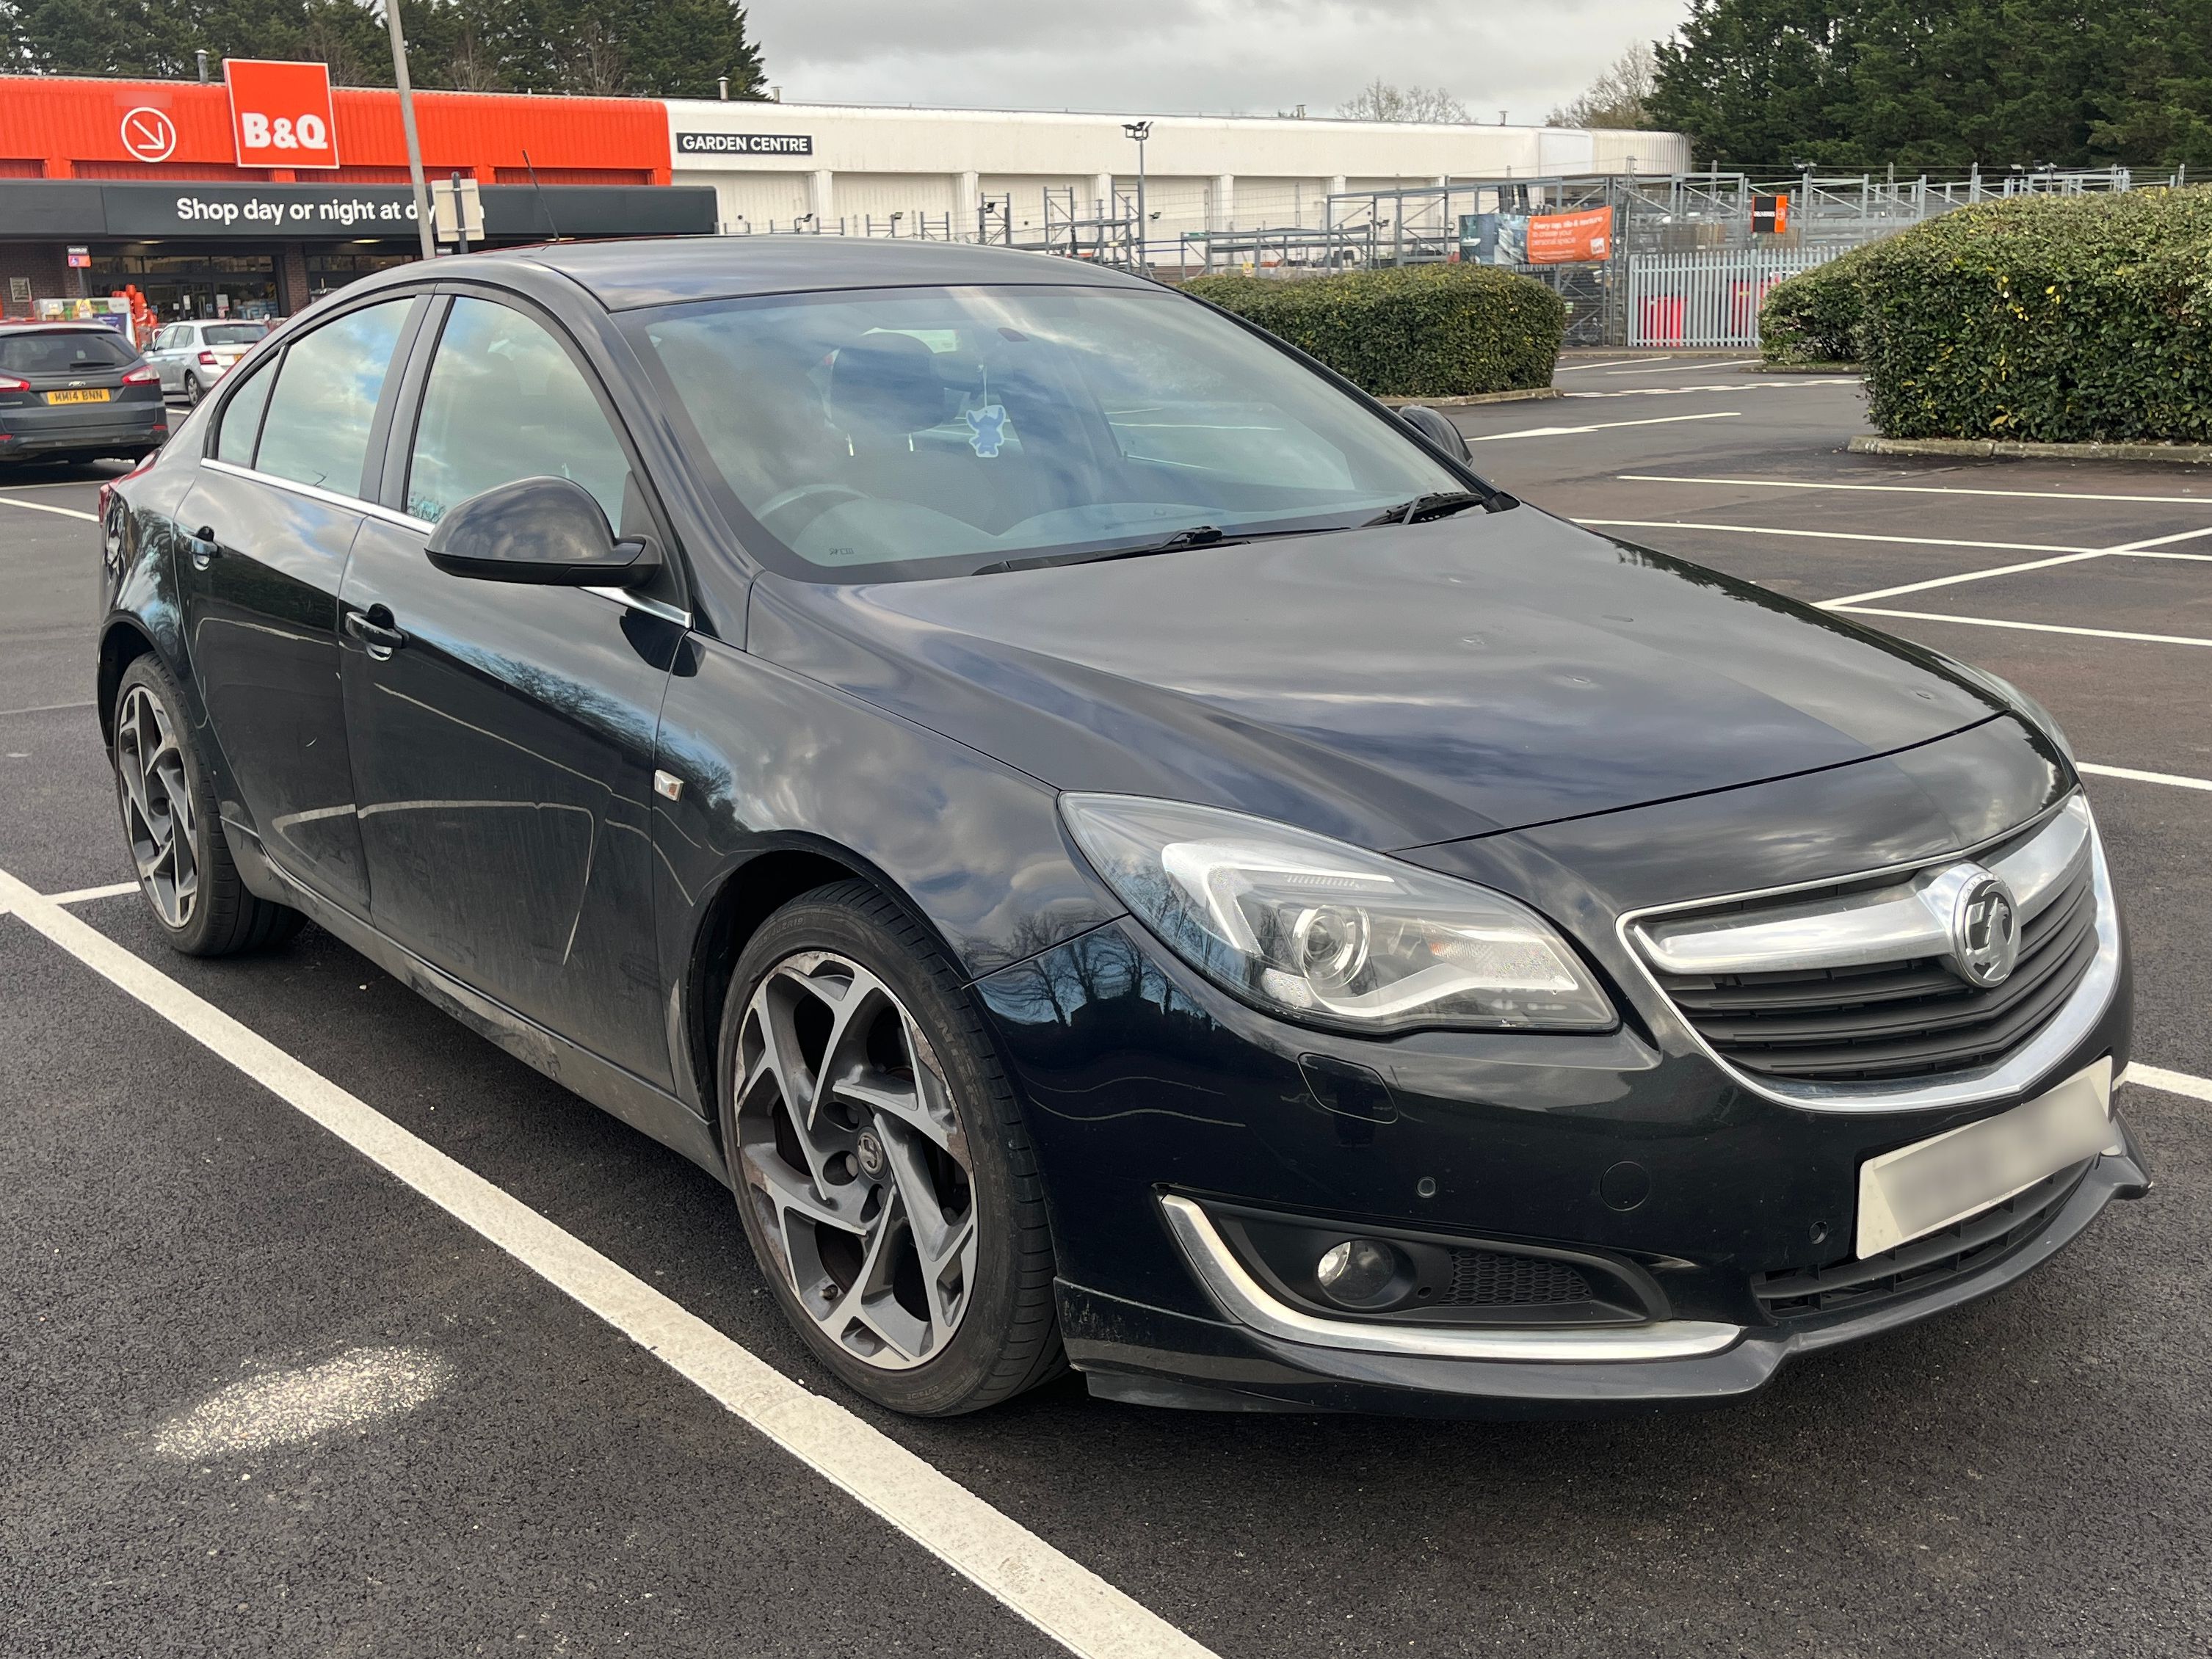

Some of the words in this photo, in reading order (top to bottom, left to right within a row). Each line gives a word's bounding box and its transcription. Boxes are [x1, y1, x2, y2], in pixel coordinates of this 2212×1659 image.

[241, 112, 329, 150] B&Q
[682, 135, 747, 151] GARDEN
[750, 137, 808, 152] CENTRE
[176, 197, 239, 225] Shop
[243, 198, 285, 226] day
[289, 203, 313, 219] or
[319, 199, 377, 225] night
[380, 201, 402, 219] at
